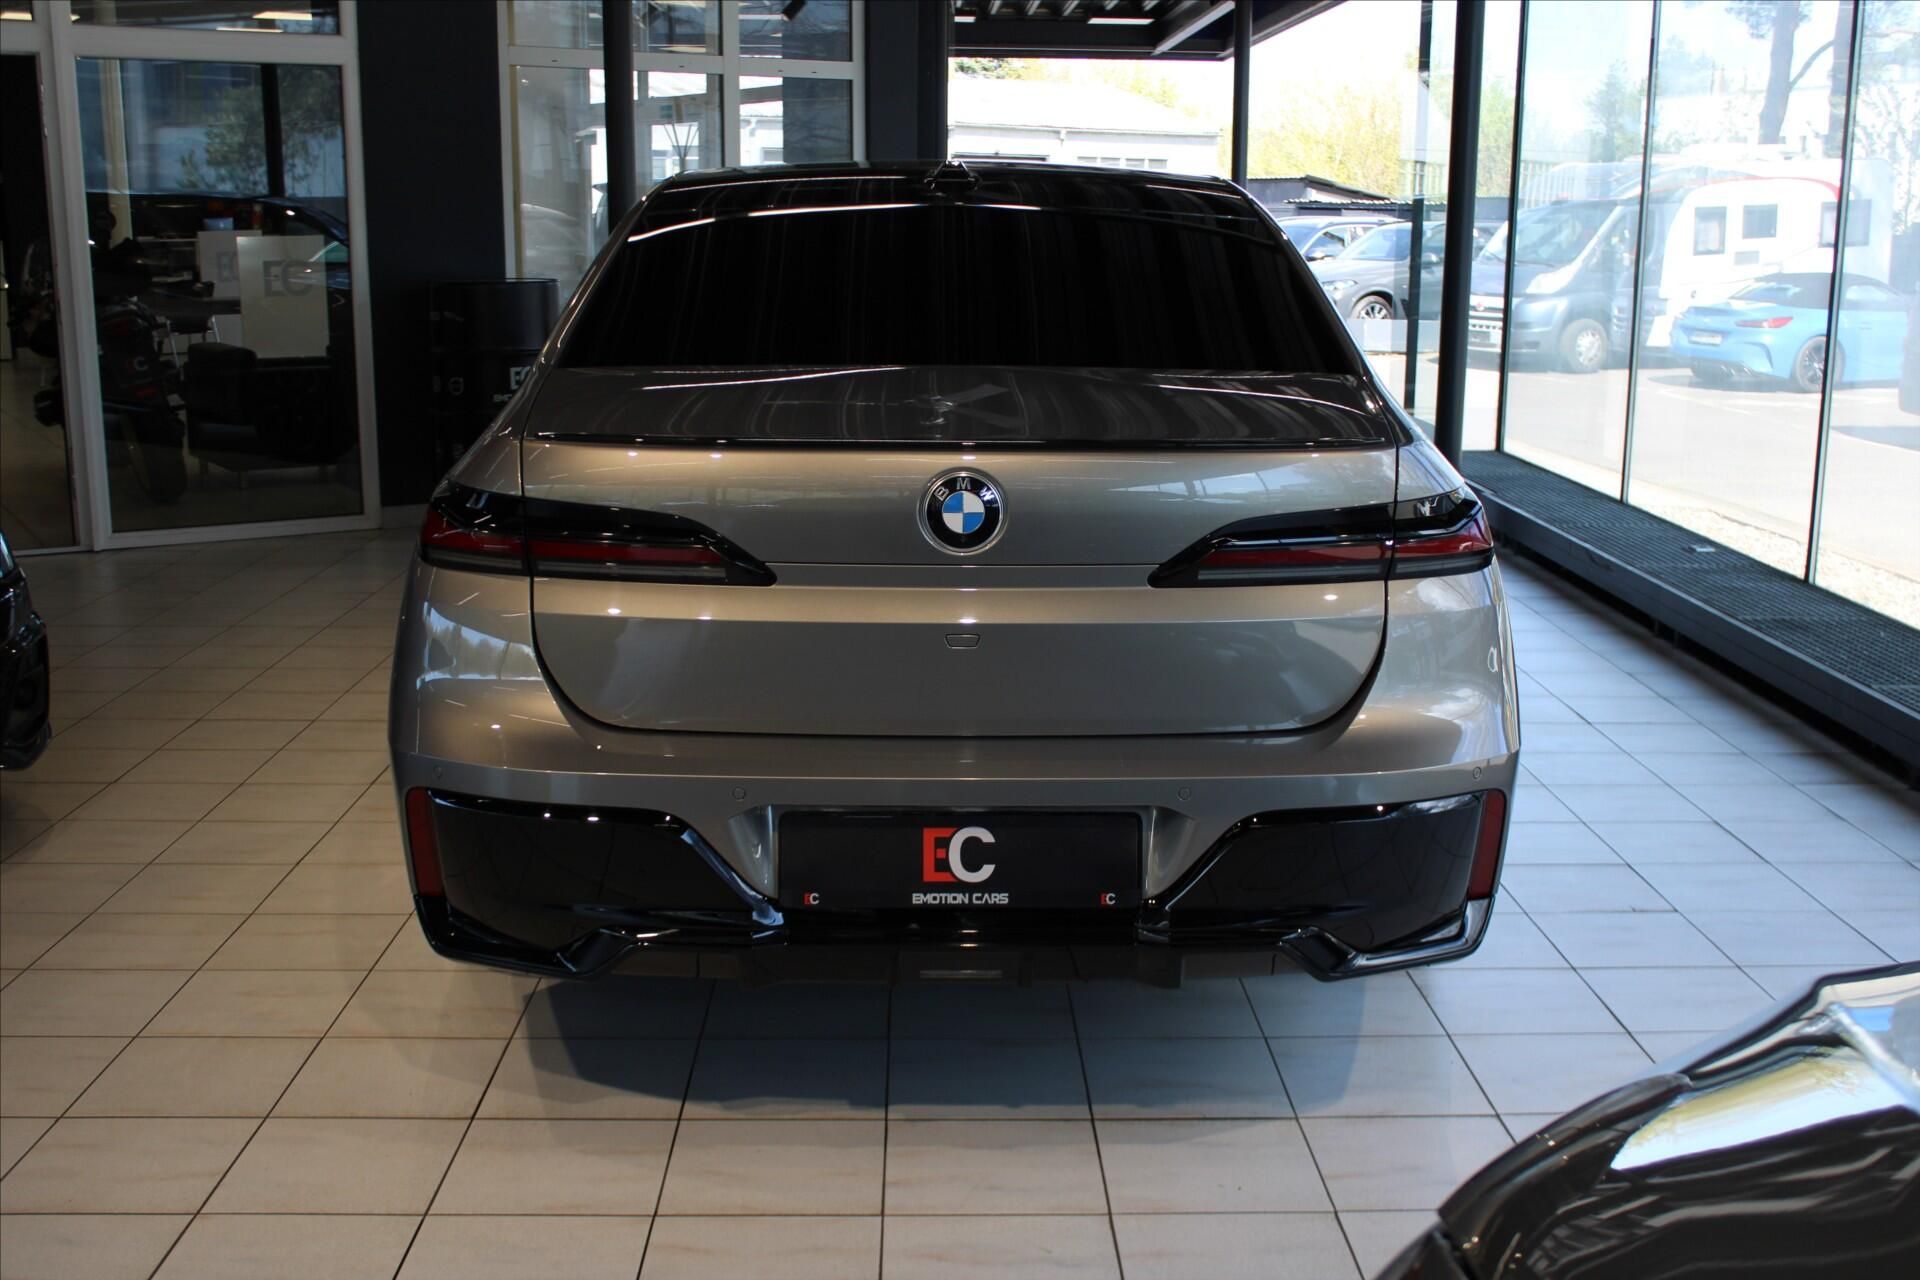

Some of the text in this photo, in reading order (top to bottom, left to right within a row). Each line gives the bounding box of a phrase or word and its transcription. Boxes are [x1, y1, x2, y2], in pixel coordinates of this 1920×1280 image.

[933, 477, 996, 502] BMW
[922, 826, 996, 883] EC
[804, 892, 820, 905] EC
[912, 892, 1009, 905] EMOTION CARS
[1101, 892, 1116, 905] EC
